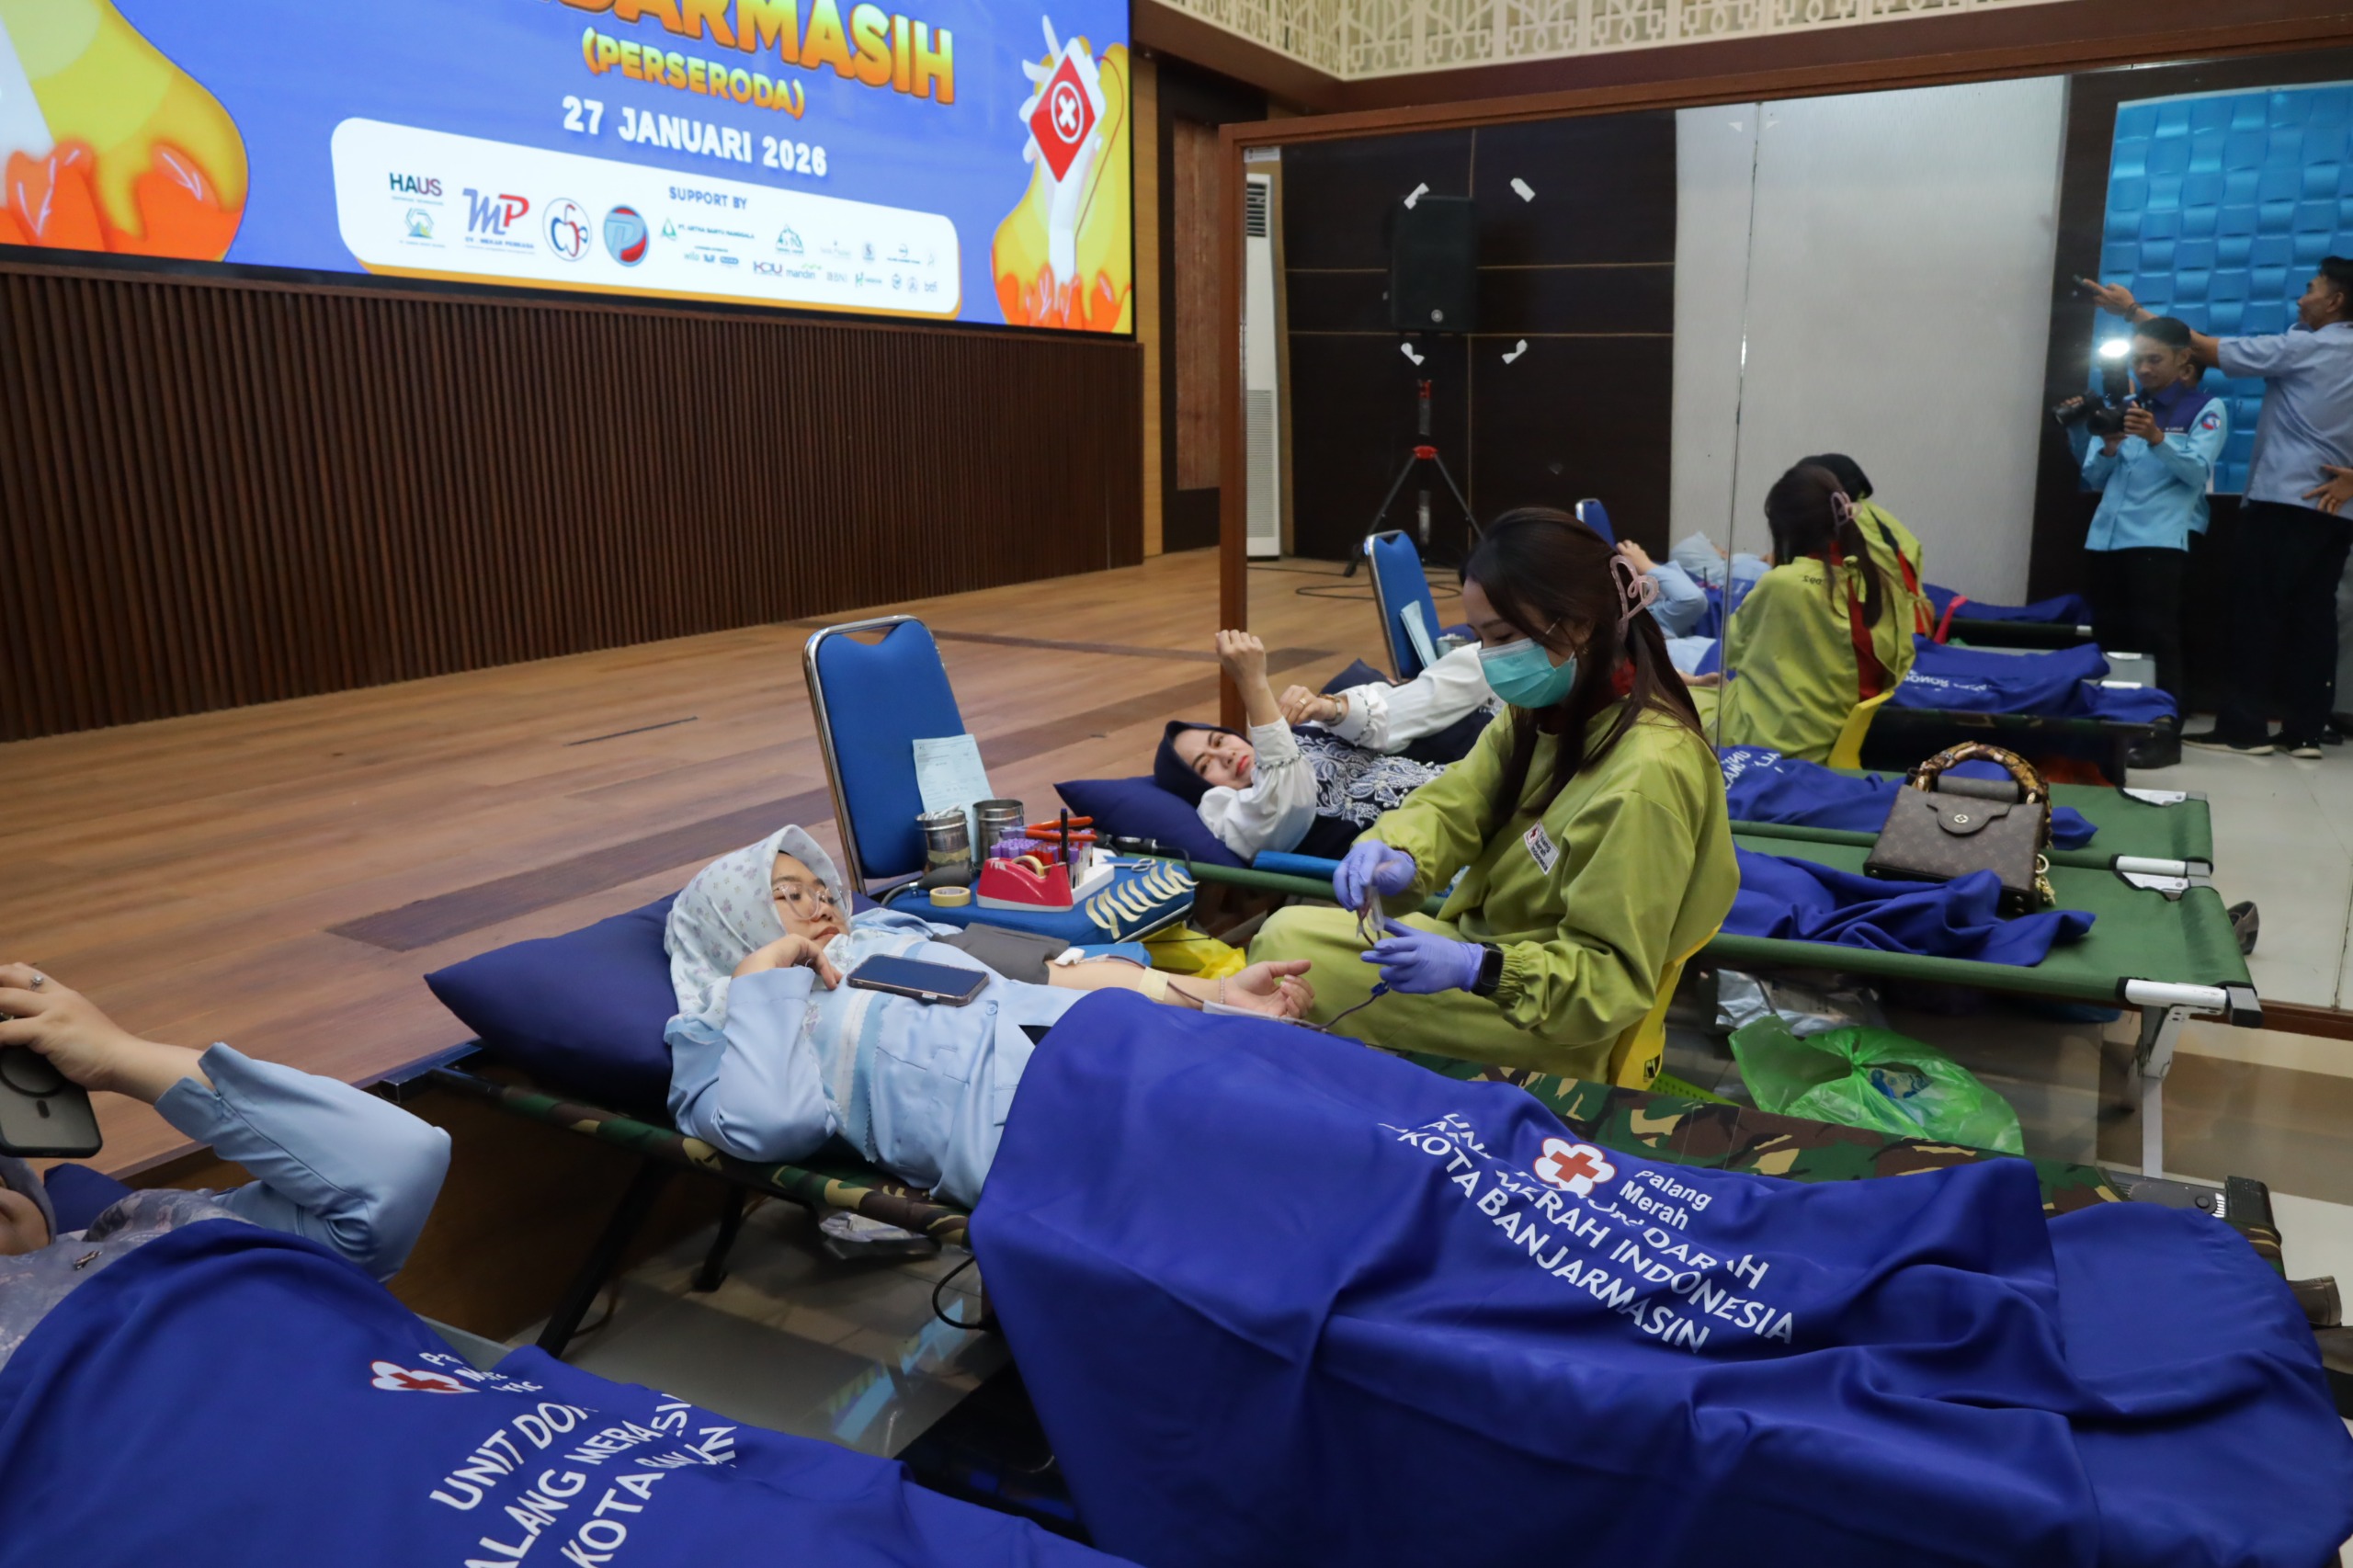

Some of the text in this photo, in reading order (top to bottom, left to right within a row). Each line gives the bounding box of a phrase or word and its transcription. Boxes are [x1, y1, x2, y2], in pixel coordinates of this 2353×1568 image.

[582, 27, 806, 120] (PERSERODA)
[562, 96, 828, 177] 27 JANUARI 2026
[389, 172, 443, 197] HAUS
[669, 186, 748, 210] SUPPORT BY
[1619, 1179, 1688, 1231] Merah
[1634, 1169, 1713, 1212] Palang
[1396, 1131, 1482, 1199] KOTA
[1476, 1187, 1711, 1355] BANJARMASIN
[1608, 1238, 1793, 1345] INDONESIA
[429, 1428, 525, 1511] UNIT
[560, 1472, 665, 1568] KOTA
